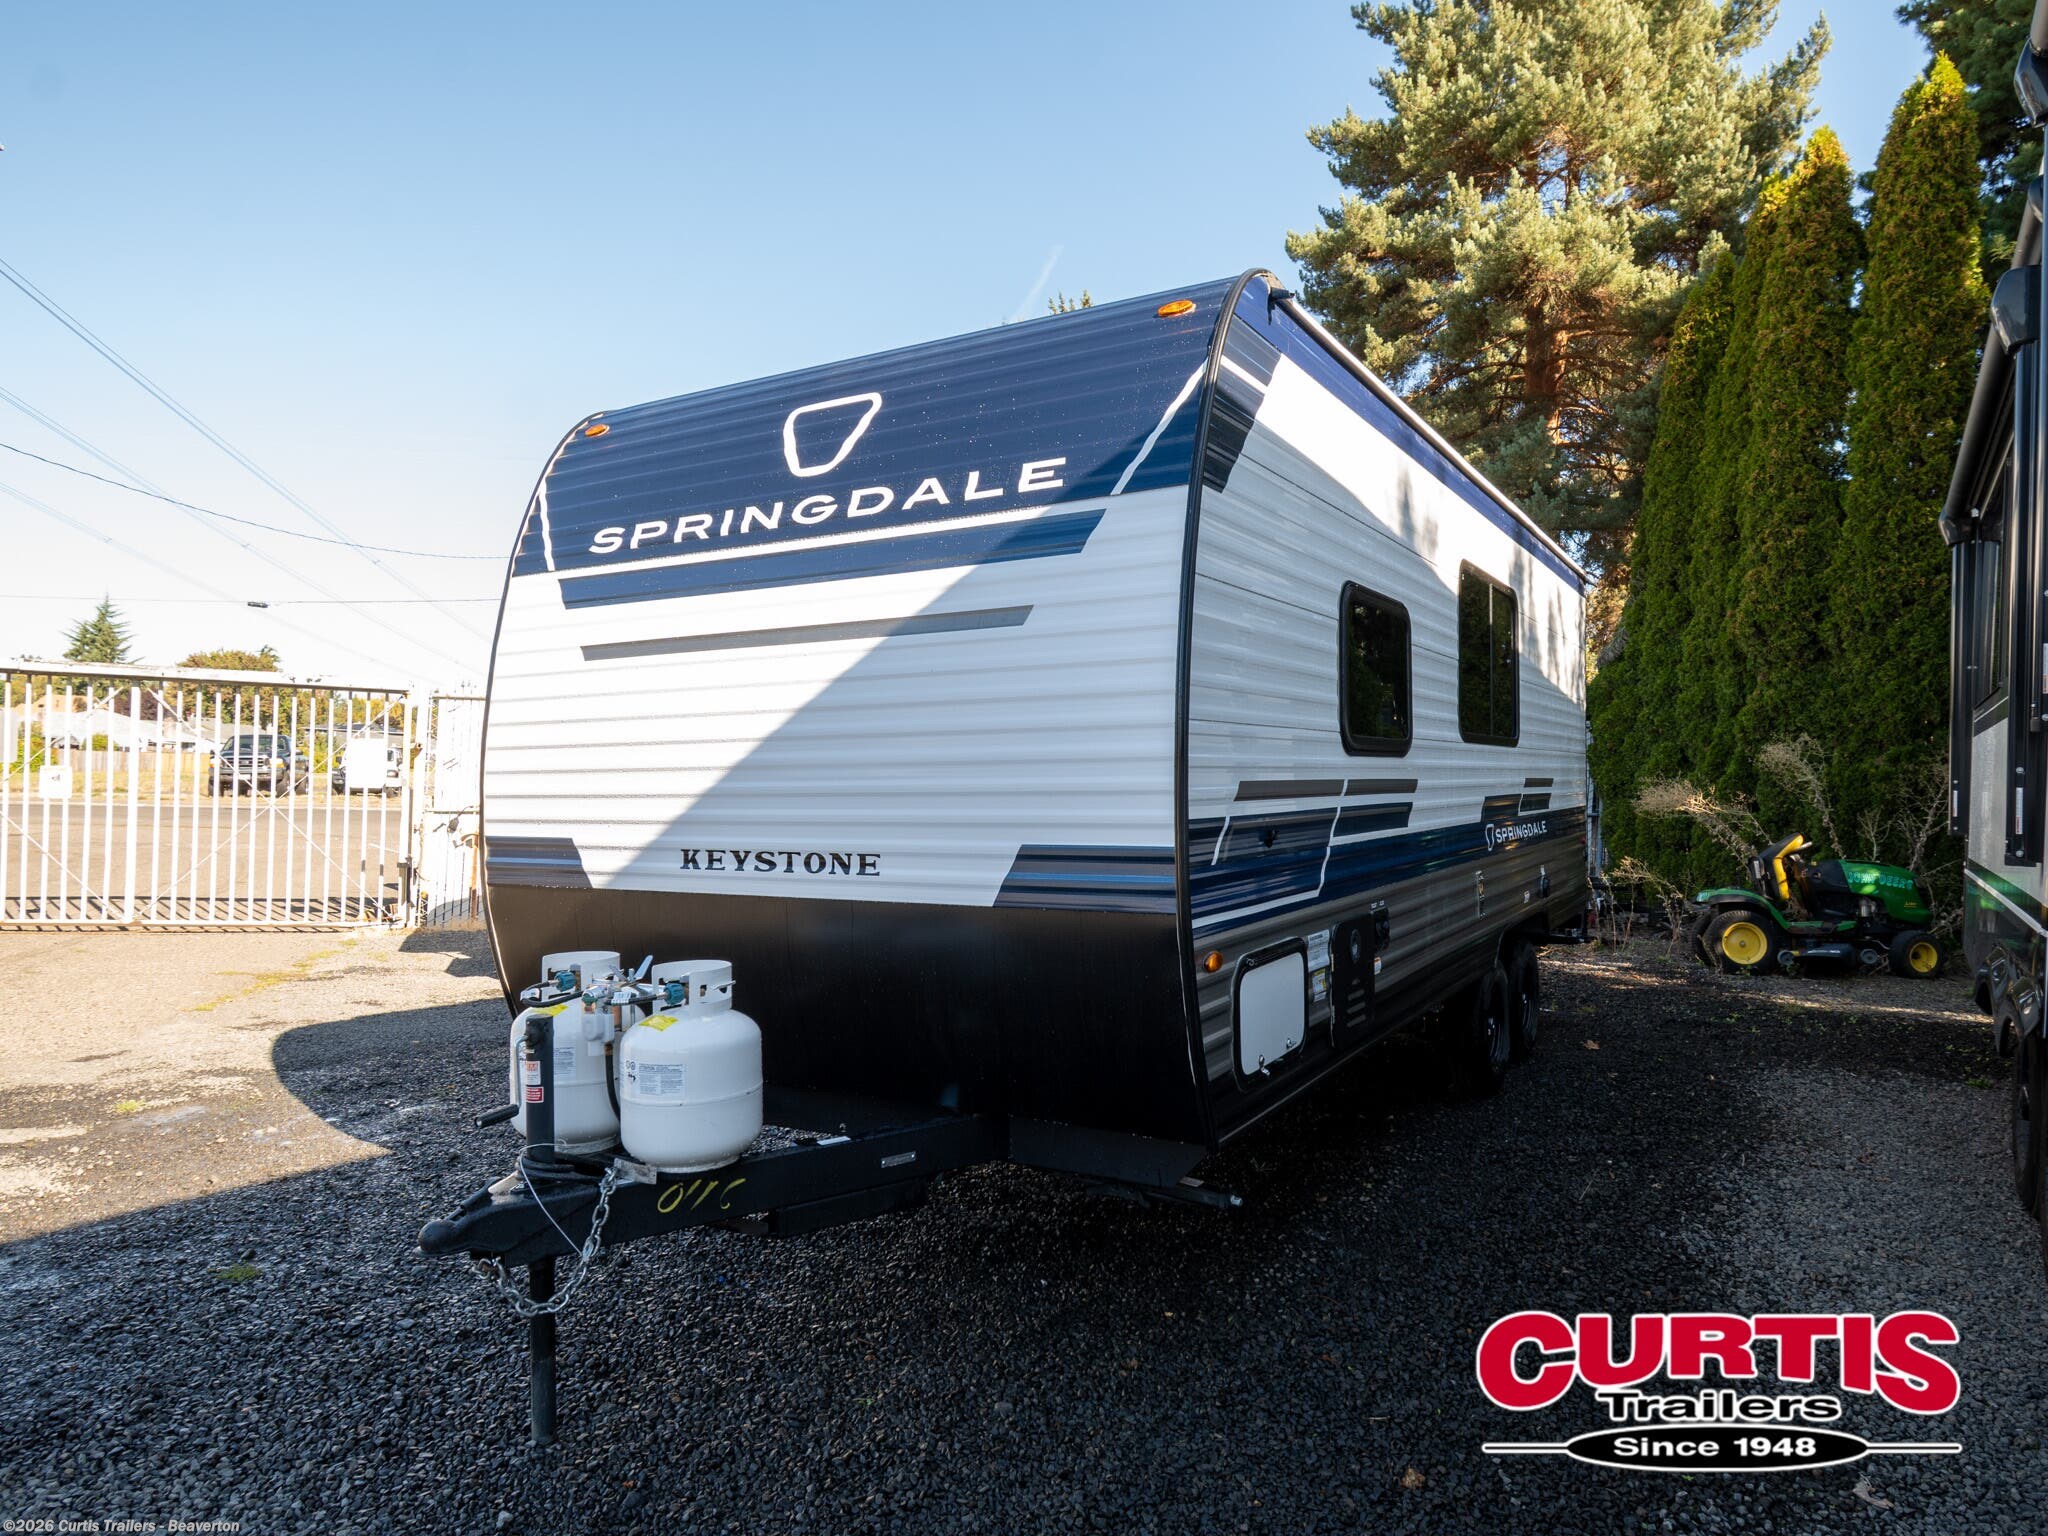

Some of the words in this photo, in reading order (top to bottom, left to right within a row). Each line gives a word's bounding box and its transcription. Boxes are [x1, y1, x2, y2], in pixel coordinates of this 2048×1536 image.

[589, 456, 1067, 554] SPRINGDALE
[1495, 820, 1548, 843] SPRINGDALE
[680, 849, 881, 876] KEYSTONE
